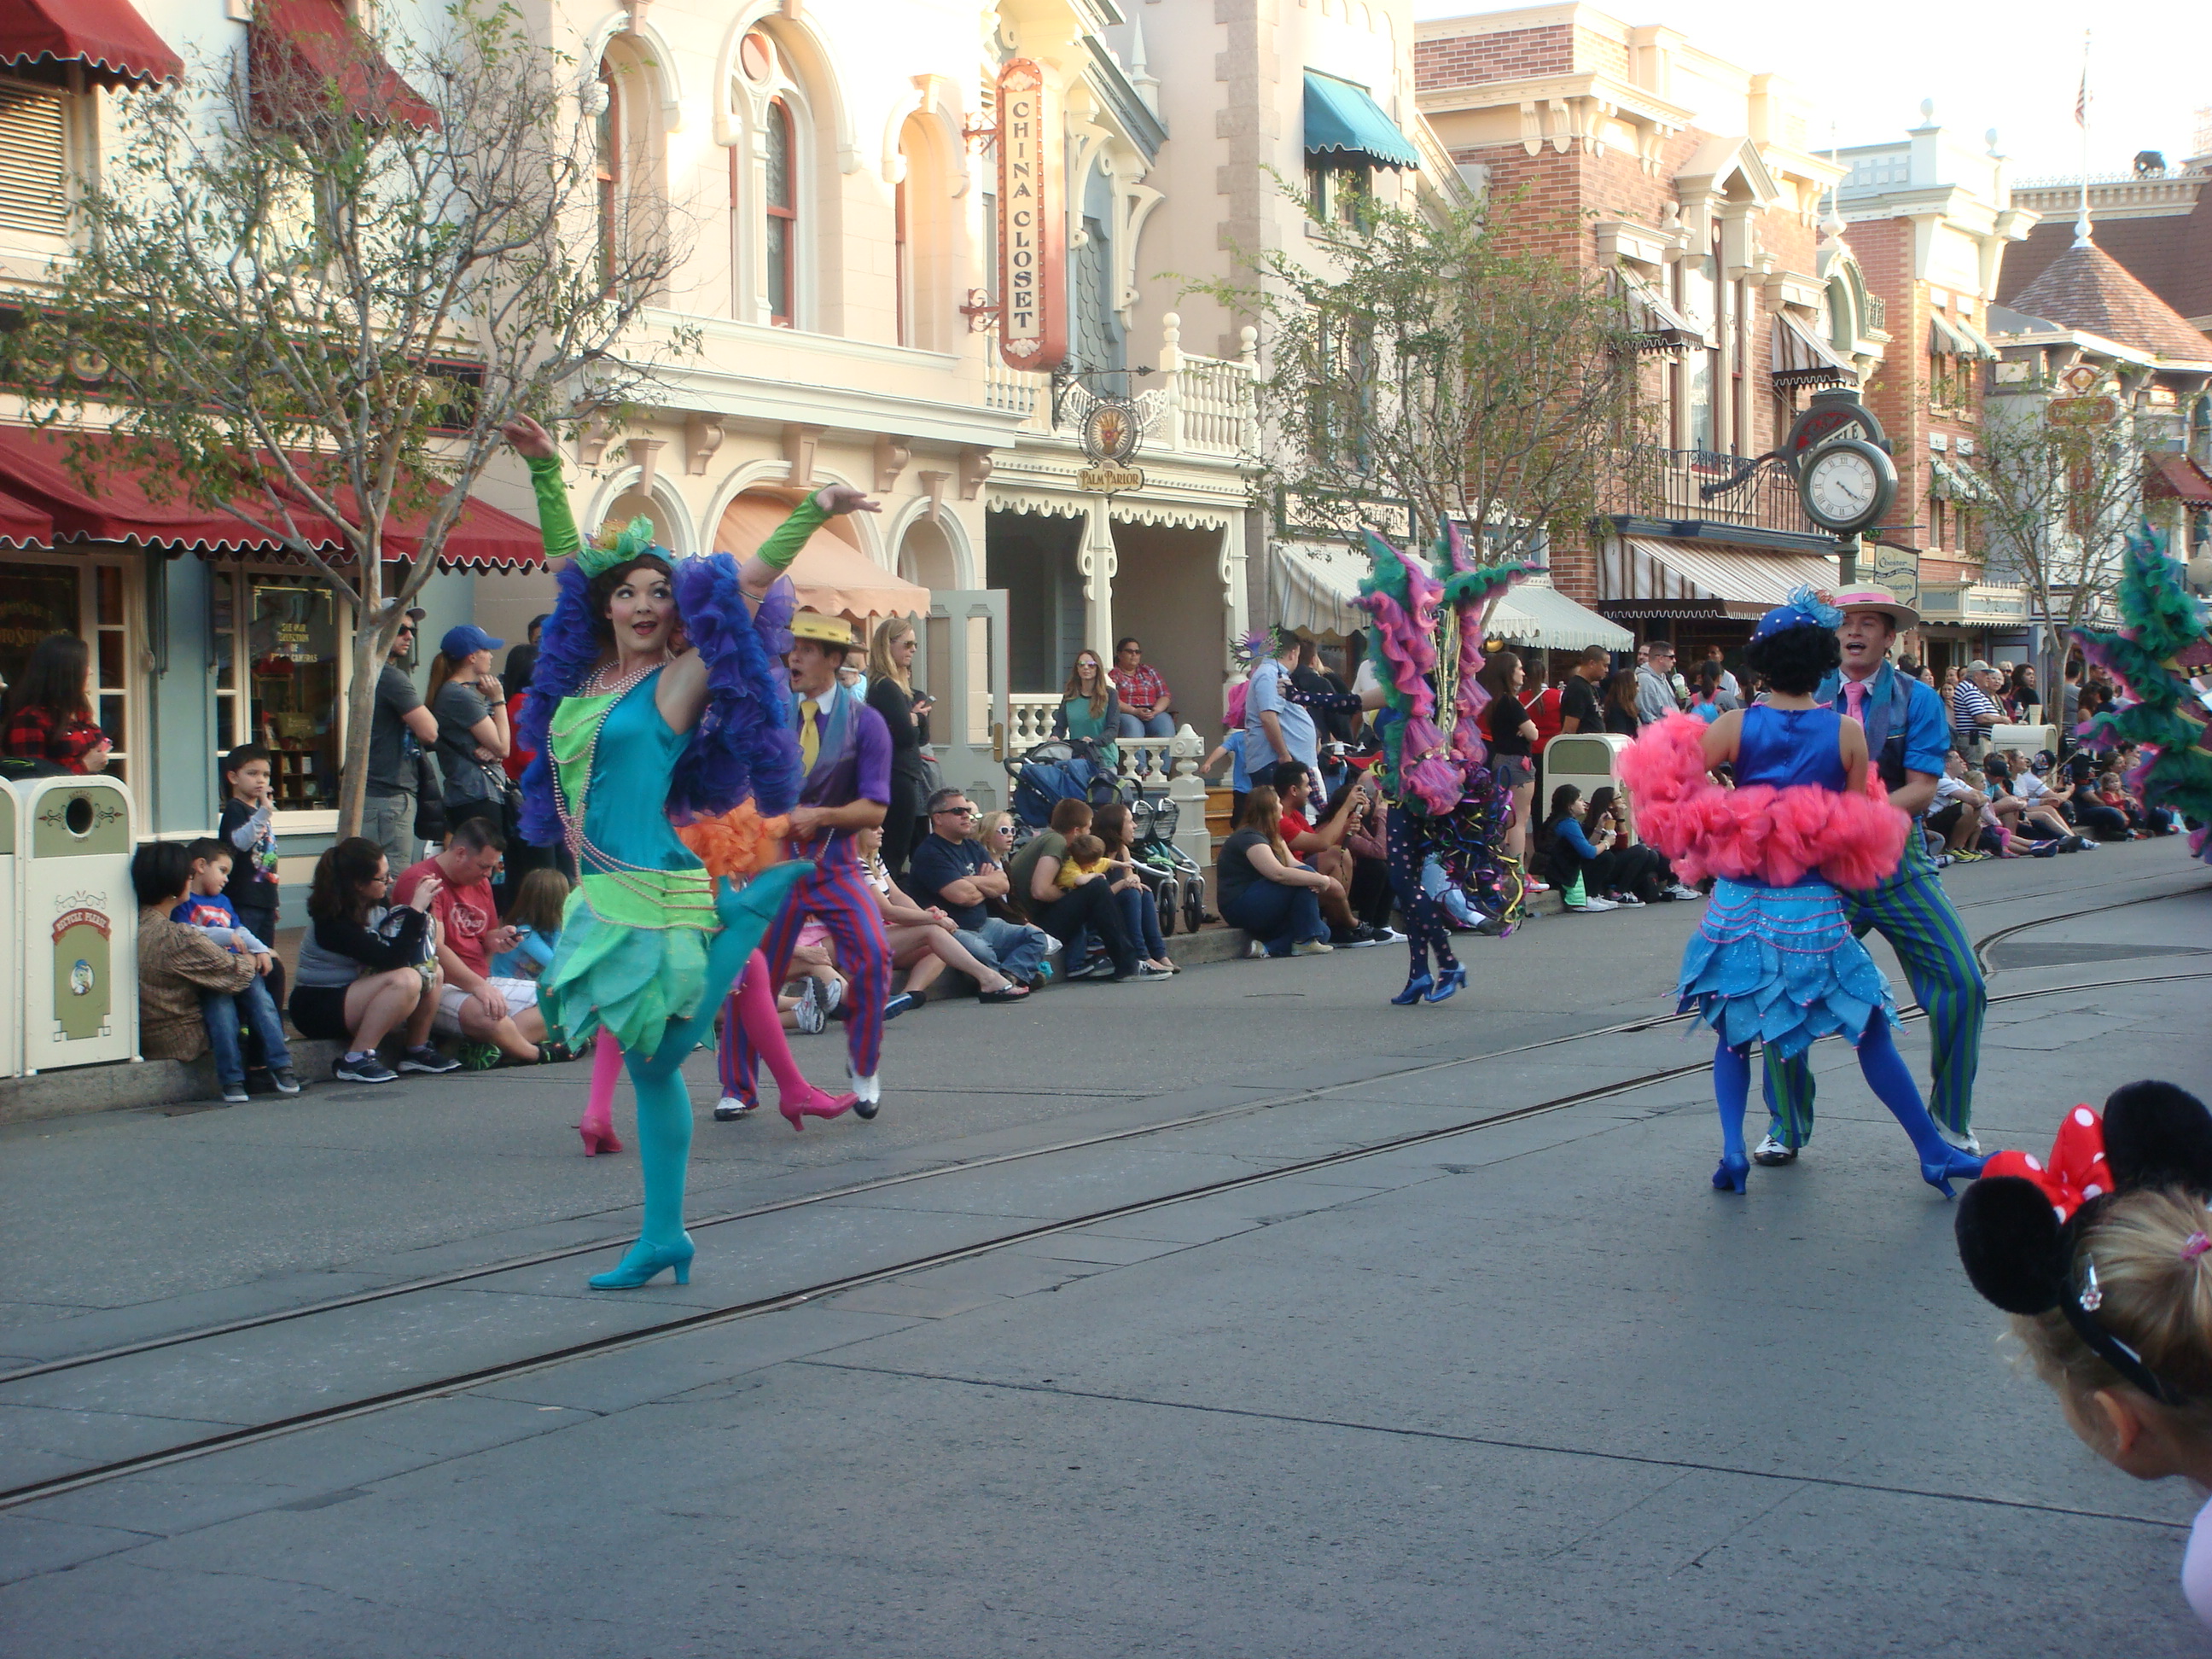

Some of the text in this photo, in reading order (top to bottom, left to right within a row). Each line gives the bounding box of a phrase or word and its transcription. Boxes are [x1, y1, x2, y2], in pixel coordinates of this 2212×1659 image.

[1012, 102, 1033, 329] CHINA CLOSET
[1080, 470, 1138, 487] PALM PARLOR
[56, 911, 107, 932] RECYCLE PLEASE
